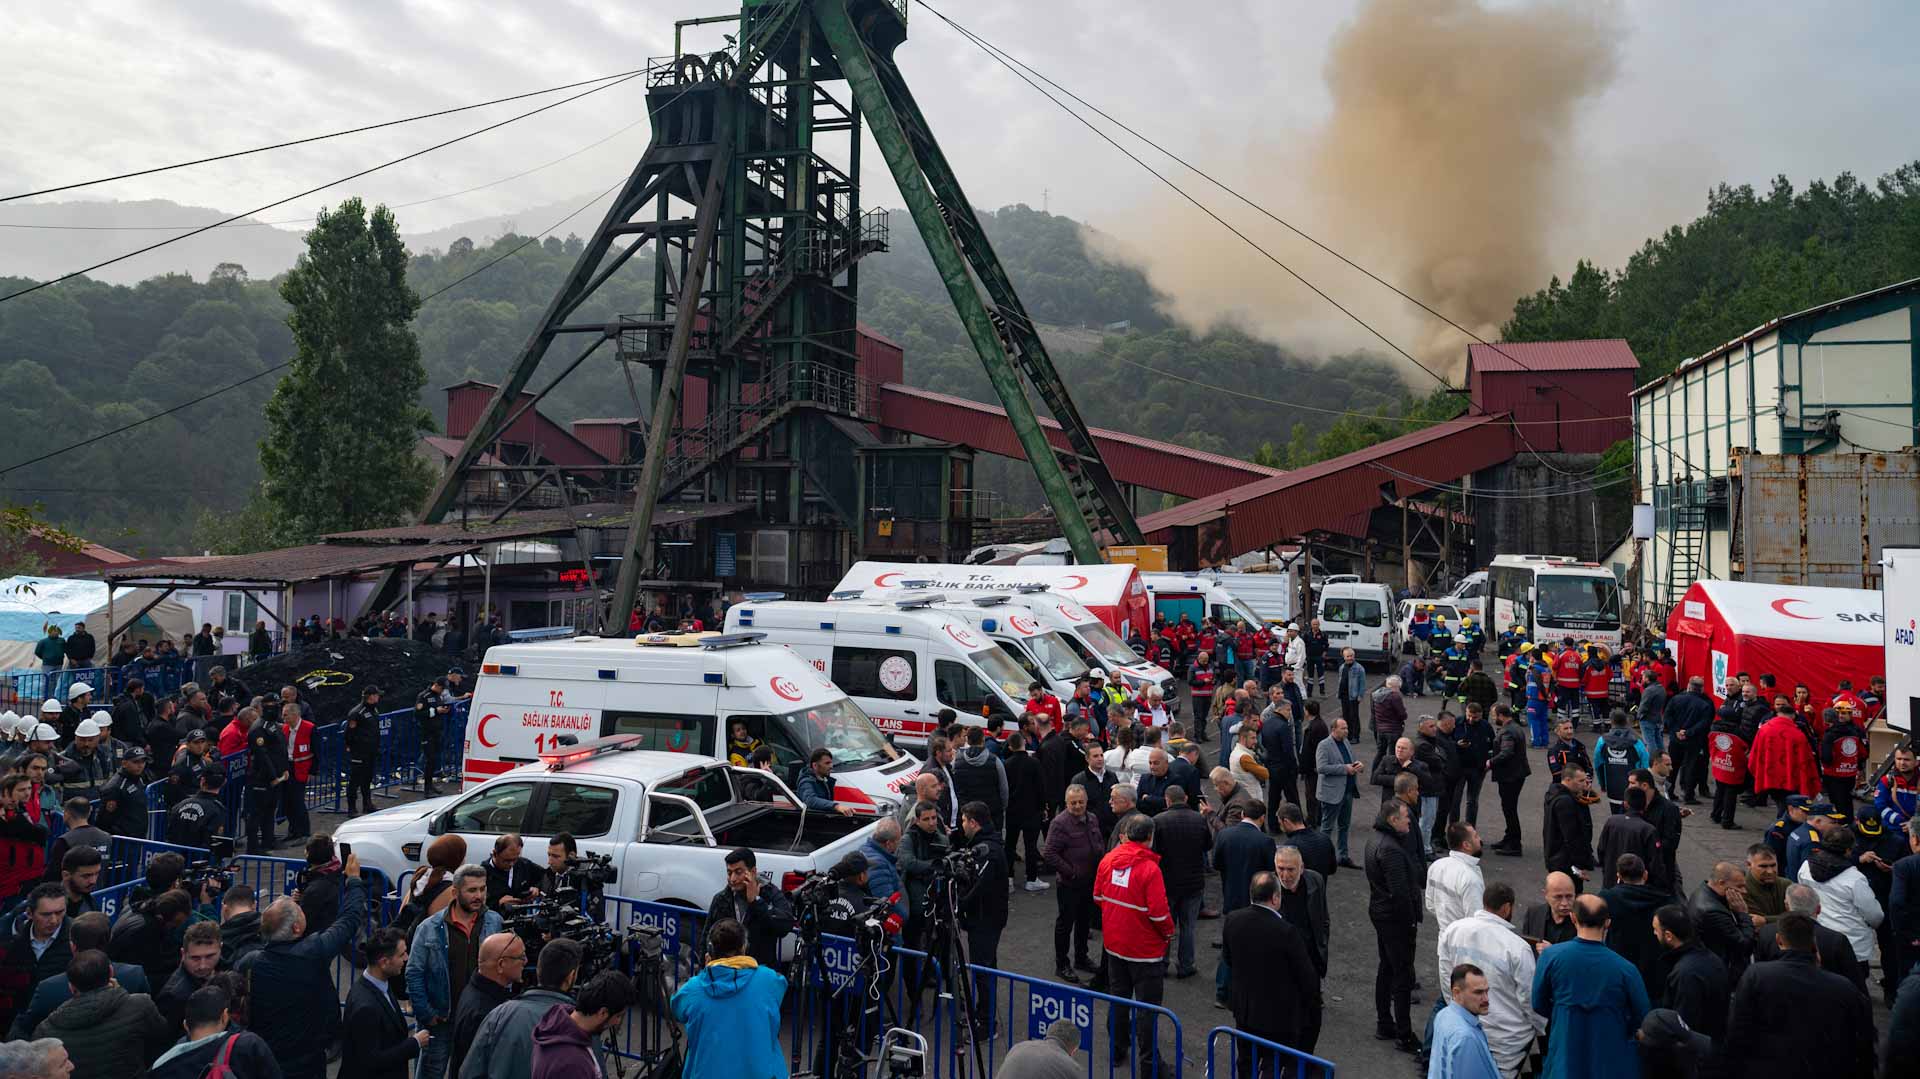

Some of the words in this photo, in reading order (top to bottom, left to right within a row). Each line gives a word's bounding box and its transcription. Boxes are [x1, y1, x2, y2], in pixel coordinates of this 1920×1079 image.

[968, 574, 995, 582] T.C.
[1836, 612, 1884, 623] SAĞ
[1564, 622, 1595, 630] ISUZU
[1895, 627, 1914, 646] AFAD
[75, 671, 95, 681] POLİS
[779, 680, 799, 695] 112
[550, 690, 565, 707] T.C.
[379, 717, 392, 729] LİS
[522, 711, 550, 728] SAĞLIK
[550, 713, 592, 730] BAKANLIĞI
[534, 732, 558, 754] 11
[229, 756, 248, 770] POLİS
[1031, 993, 1090, 1028] POLİS
